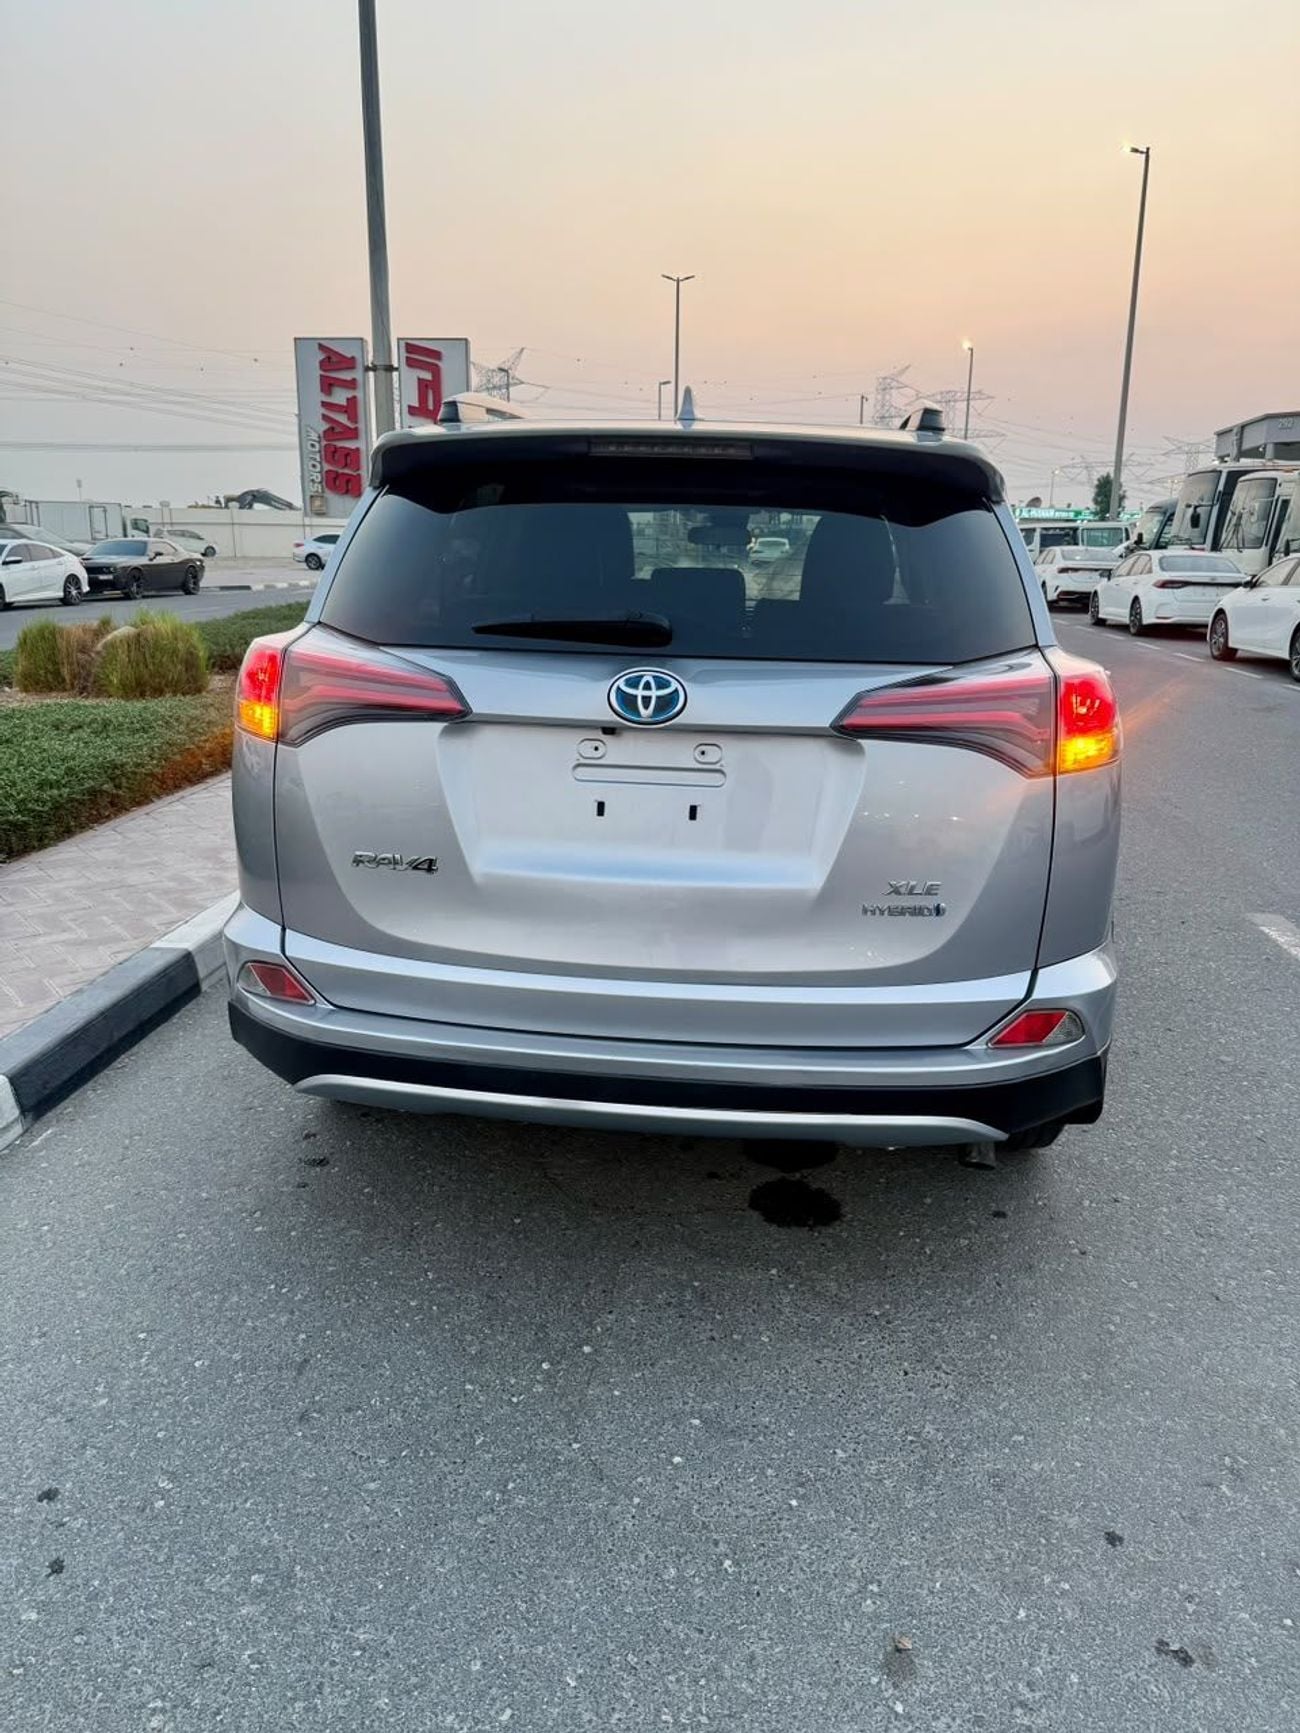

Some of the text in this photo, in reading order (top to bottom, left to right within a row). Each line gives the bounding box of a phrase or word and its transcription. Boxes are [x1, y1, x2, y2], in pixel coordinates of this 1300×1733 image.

[404, 342, 443, 428] الط
[318, 342, 362, 498] ALTASS
[305, 427, 322, 494] MOTORS
[352, 851, 438, 874] RAV4
[861, 903, 933, 917] HYBRID
[881, 880, 941, 896] XLE
